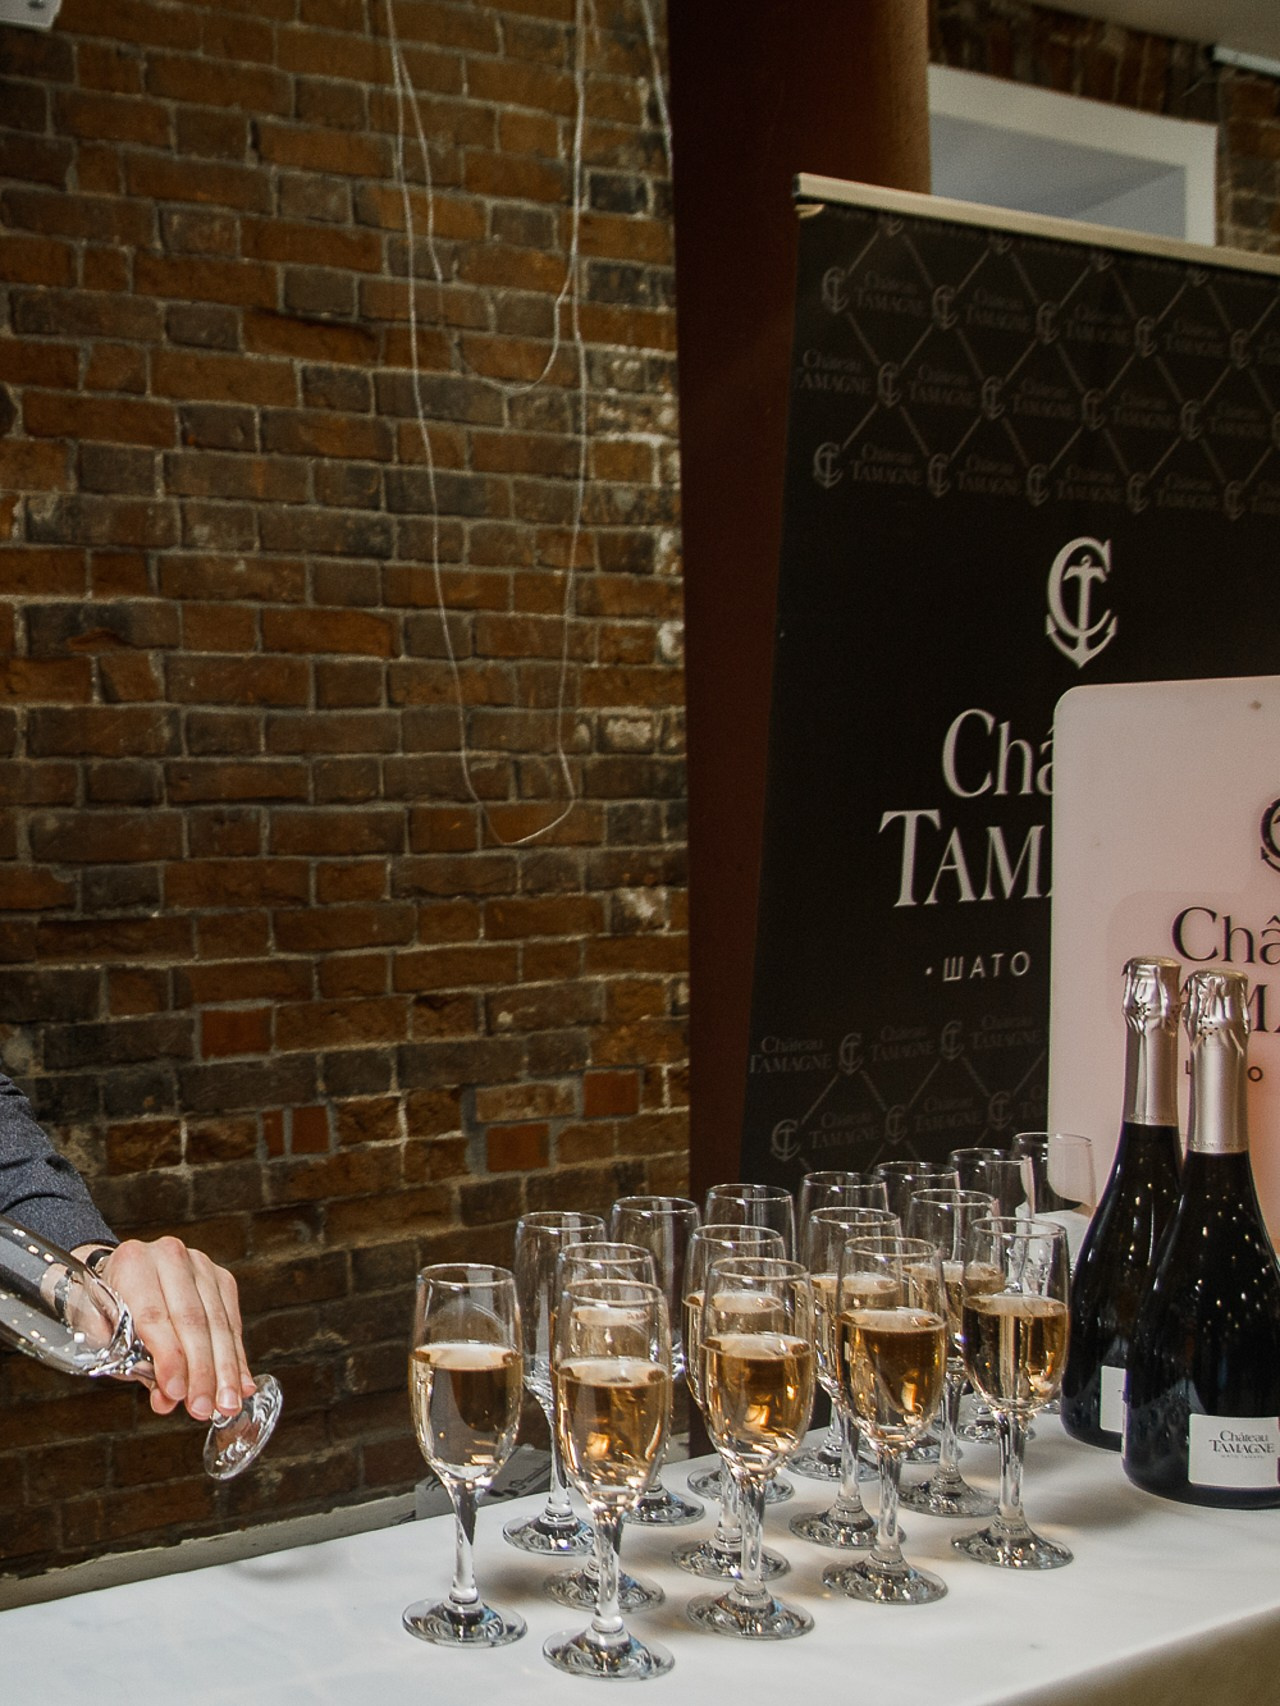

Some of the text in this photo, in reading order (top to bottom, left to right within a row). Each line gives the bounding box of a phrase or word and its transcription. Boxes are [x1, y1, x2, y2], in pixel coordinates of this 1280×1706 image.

[878, 808, 1053, 908] TAM
[943, 951, 1030, 982] ШАТО
[750, 1055, 834, 1077] TAMAGNE
[1209, 1440, 1275, 1454] TAMAGNE
